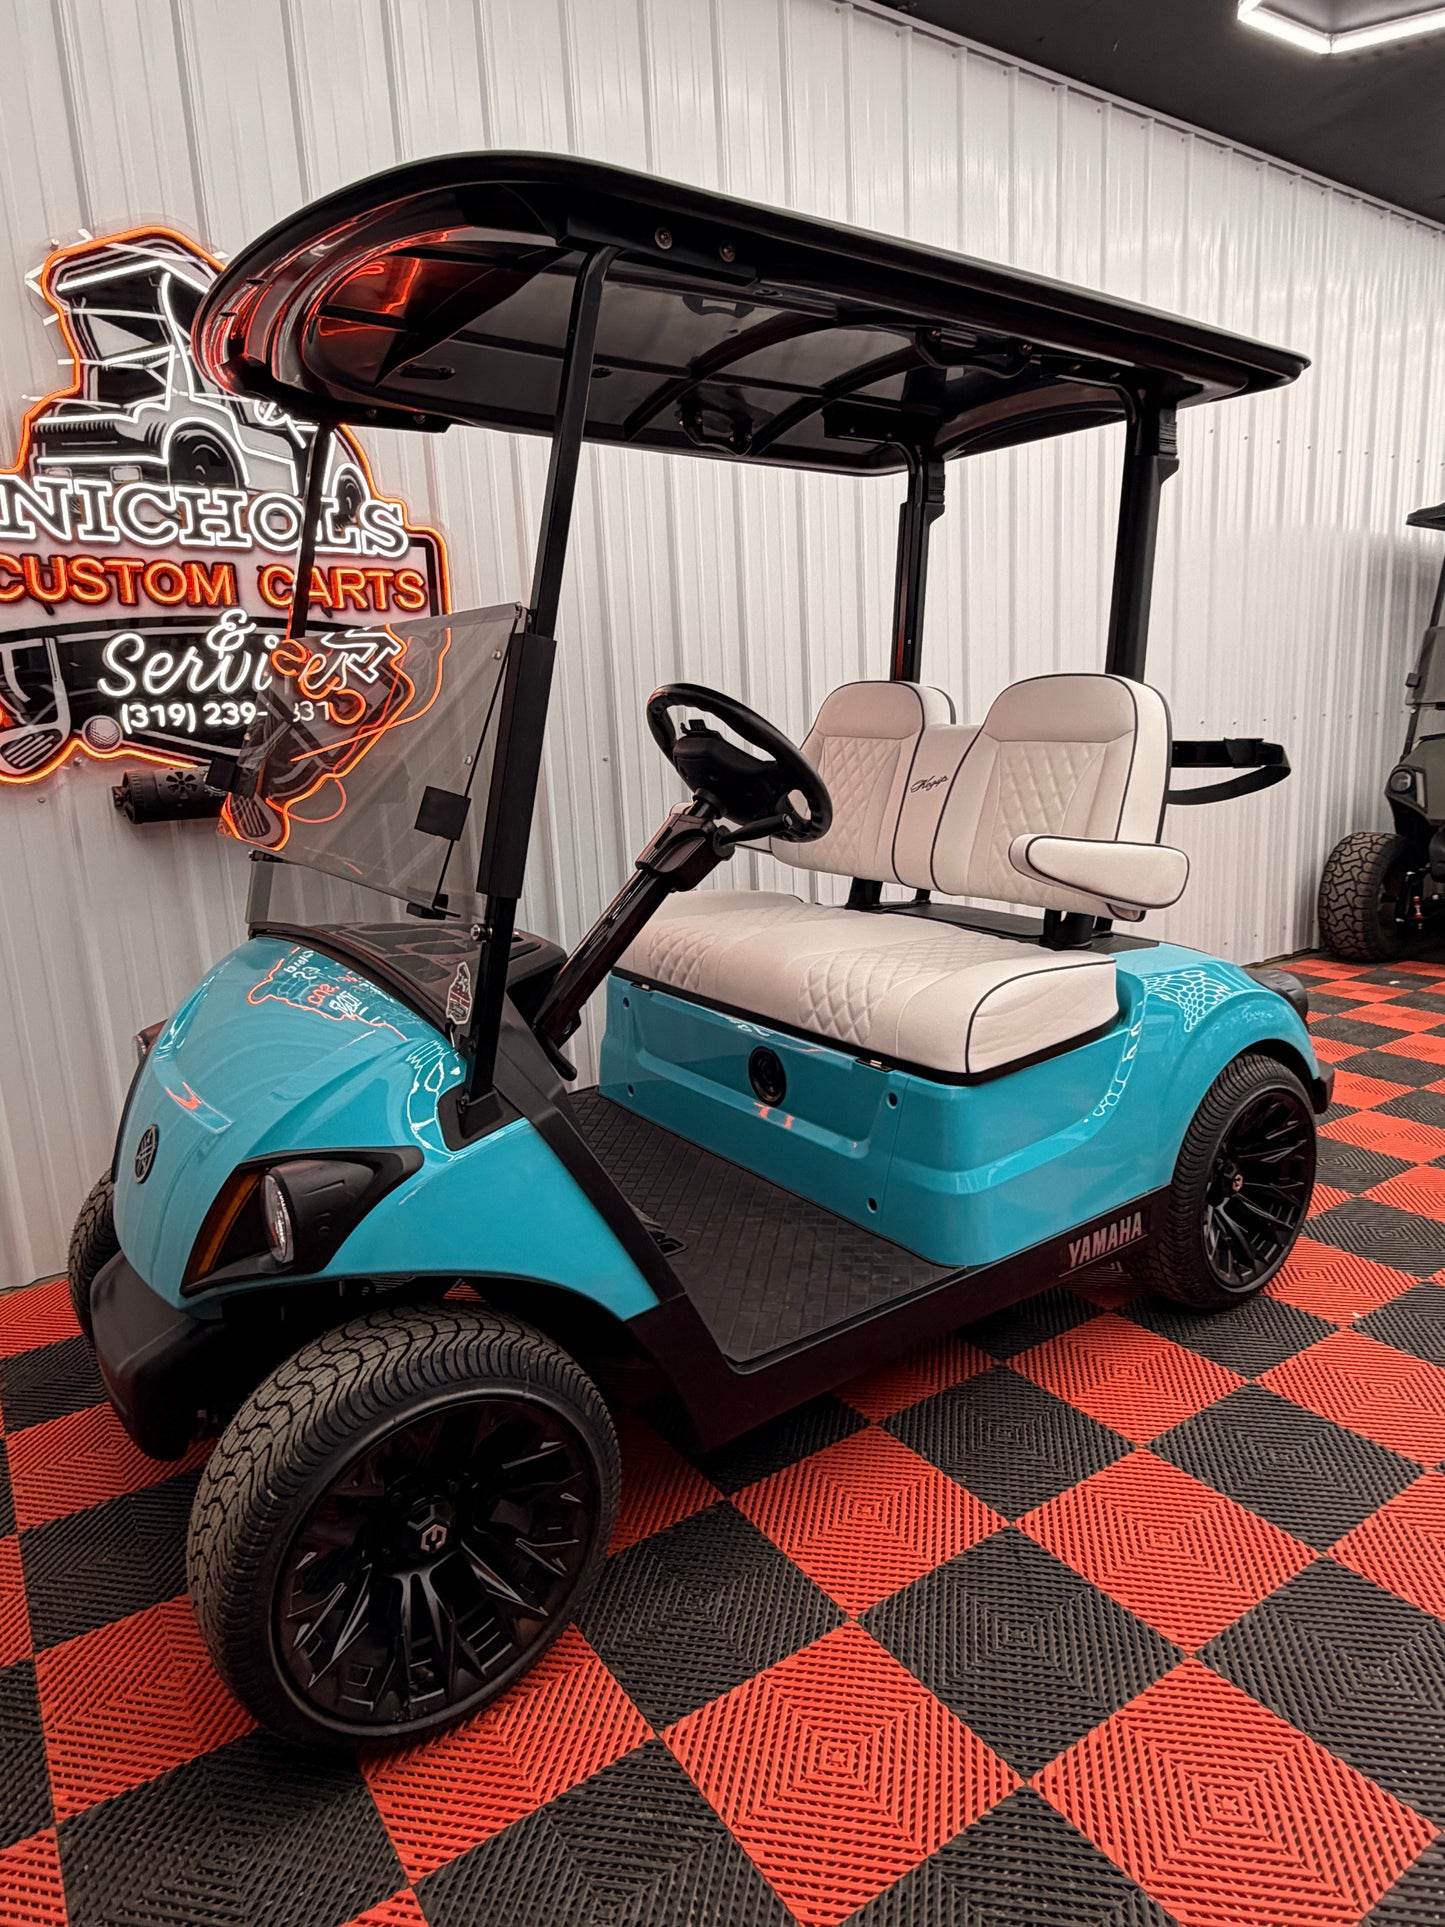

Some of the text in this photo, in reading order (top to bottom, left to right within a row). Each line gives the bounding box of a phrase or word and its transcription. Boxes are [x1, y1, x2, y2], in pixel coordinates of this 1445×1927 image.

[0, 473, 410, 558] NICHOLS
[0, 552, 428, 612] CUSTOM CARTS
[206, 608, 257, 660] &
[97, 632, 350, 697] Servies
[120, 702, 196, 735] (319)
[1068, 1211, 1143, 1269] YAMAHA
